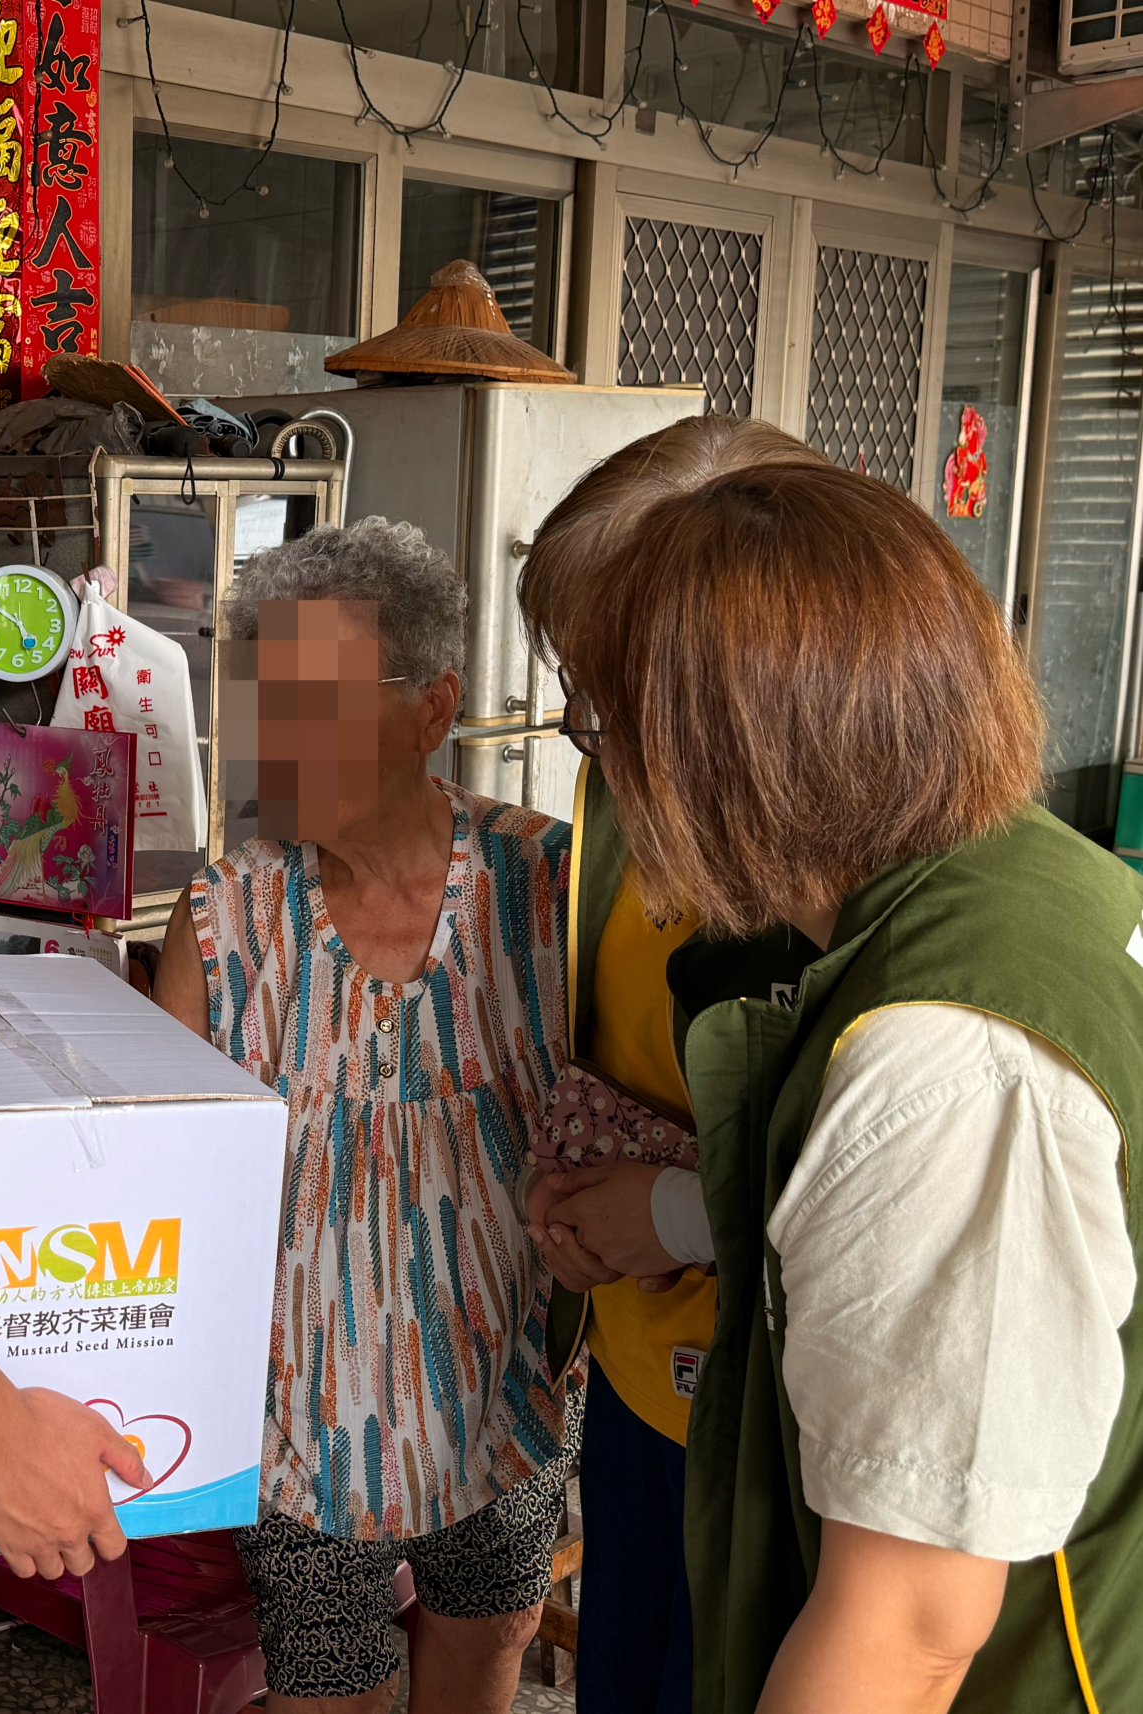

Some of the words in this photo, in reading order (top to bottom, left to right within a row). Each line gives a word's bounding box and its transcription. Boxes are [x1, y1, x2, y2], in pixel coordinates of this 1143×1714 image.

[30, 0, 95, 353] 如意人吉
[14, 579, 32, 593] 12
[37, 586, 43, 600] 1
[46, 598, 57, 613] 2
[49, 618, 61, 633] 3
[42, 636, 55, 651] 4
[11, 654, 24, 668] 6
[31, 650, 43, 664] 5
[69, 648, 84, 659] ew
[136, 668, 162, 766] 衛生可口
[7, 1341, 68, 1357] Mustard
[76, 1338, 109, 1352] Seed
[116, 1336, 174, 1349] Mission
